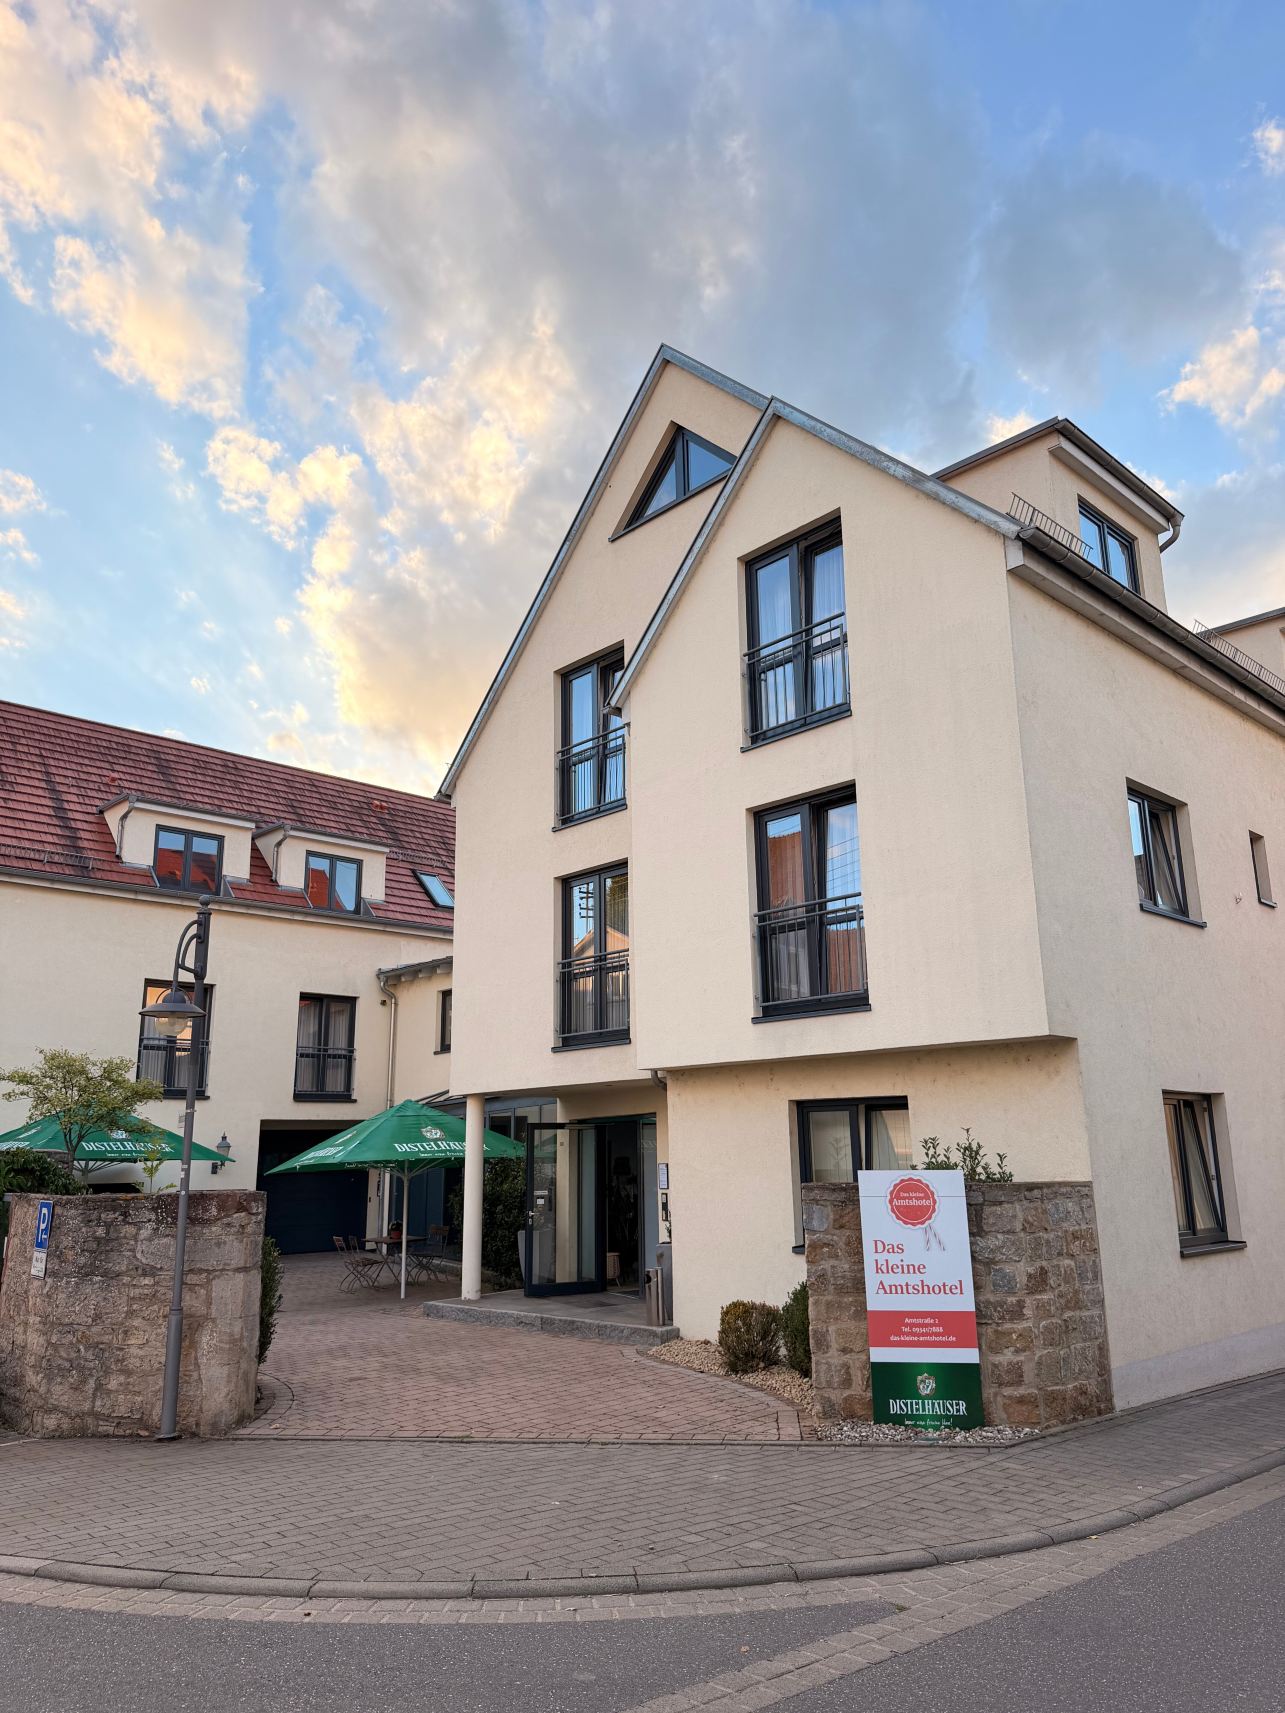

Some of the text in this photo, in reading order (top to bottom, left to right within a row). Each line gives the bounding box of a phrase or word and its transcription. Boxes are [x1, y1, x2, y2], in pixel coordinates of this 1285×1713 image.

[893, 1198, 933, 1206] Amtshotel
[38, 1207, 48, 1243] P
[873, 1239, 905, 1254] Das
[875, 1258, 927, 1275] kleine
[875, 1279, 965, 1296] Amtshotel
[889, 1399, 968, 1416] DISTELHÄUSER
